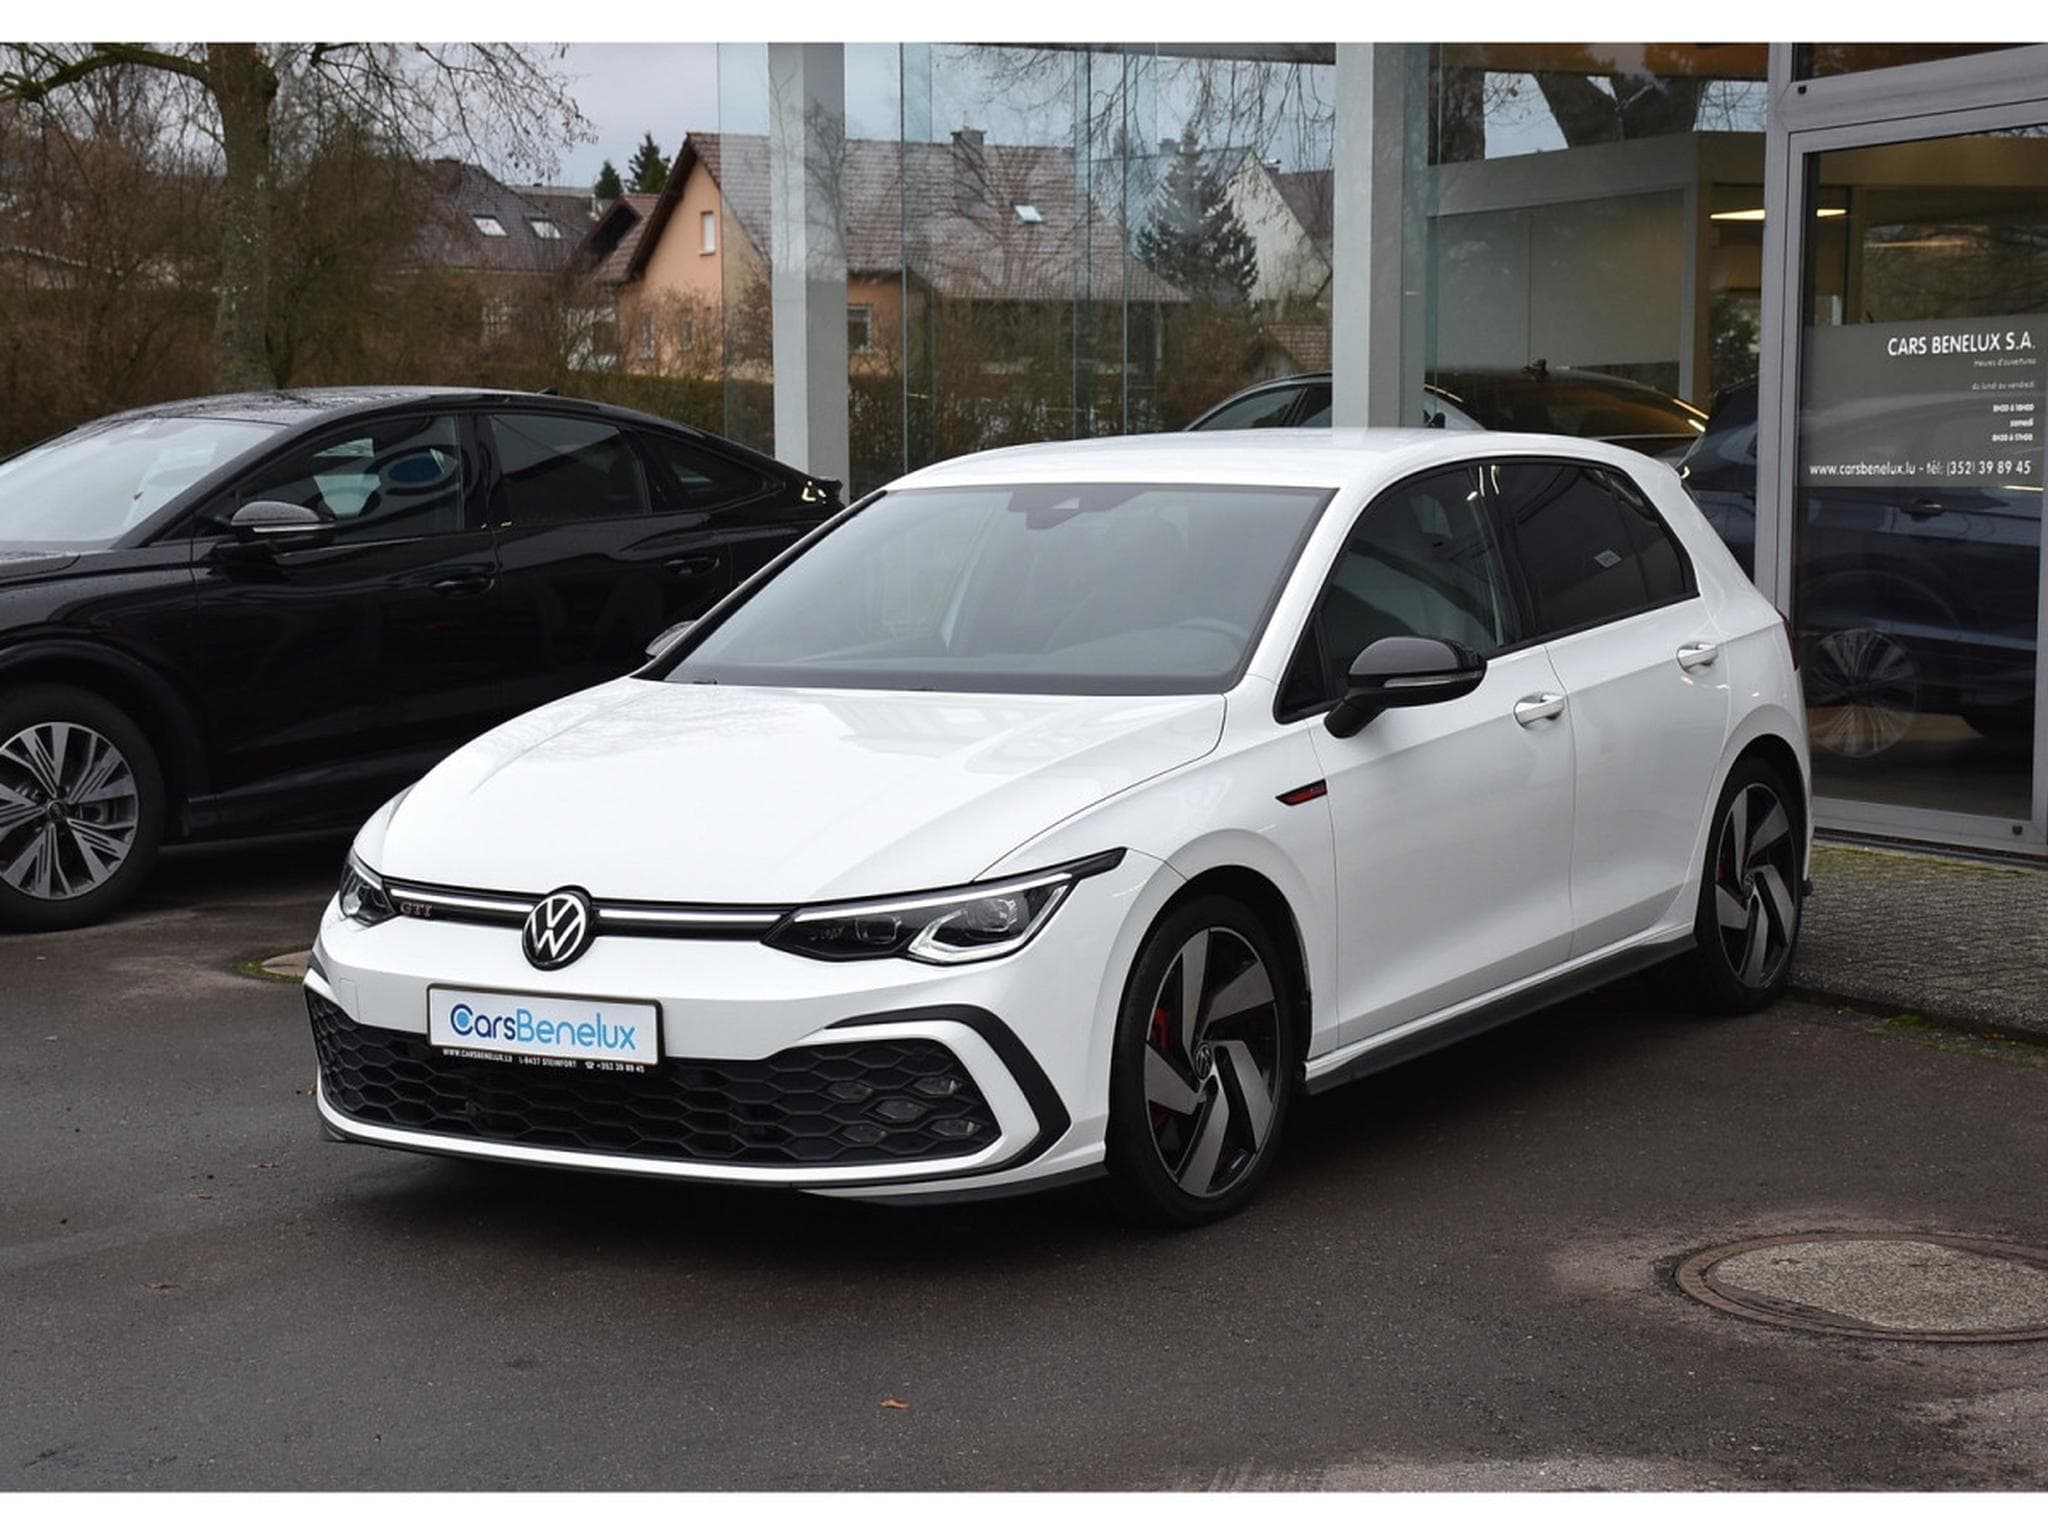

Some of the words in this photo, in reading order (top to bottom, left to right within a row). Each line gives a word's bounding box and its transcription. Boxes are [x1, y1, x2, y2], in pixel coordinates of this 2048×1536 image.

[1887, 336, 1927, 356] CARS
[1931, 332, 2001, 355] BENELUX
[2005, 330, 2036, 351] S.A.
[1808, 459, 1917, 476] www.carsbenelux.lu
[1978, 460, 1994, 476] 39
[1996, 460, 2013, 476] 89
[2015, 460, 2032, 475] 45
[400, 901, 433, 917] GTI
[449, 1003, 637, 1051] CarsBenelux
